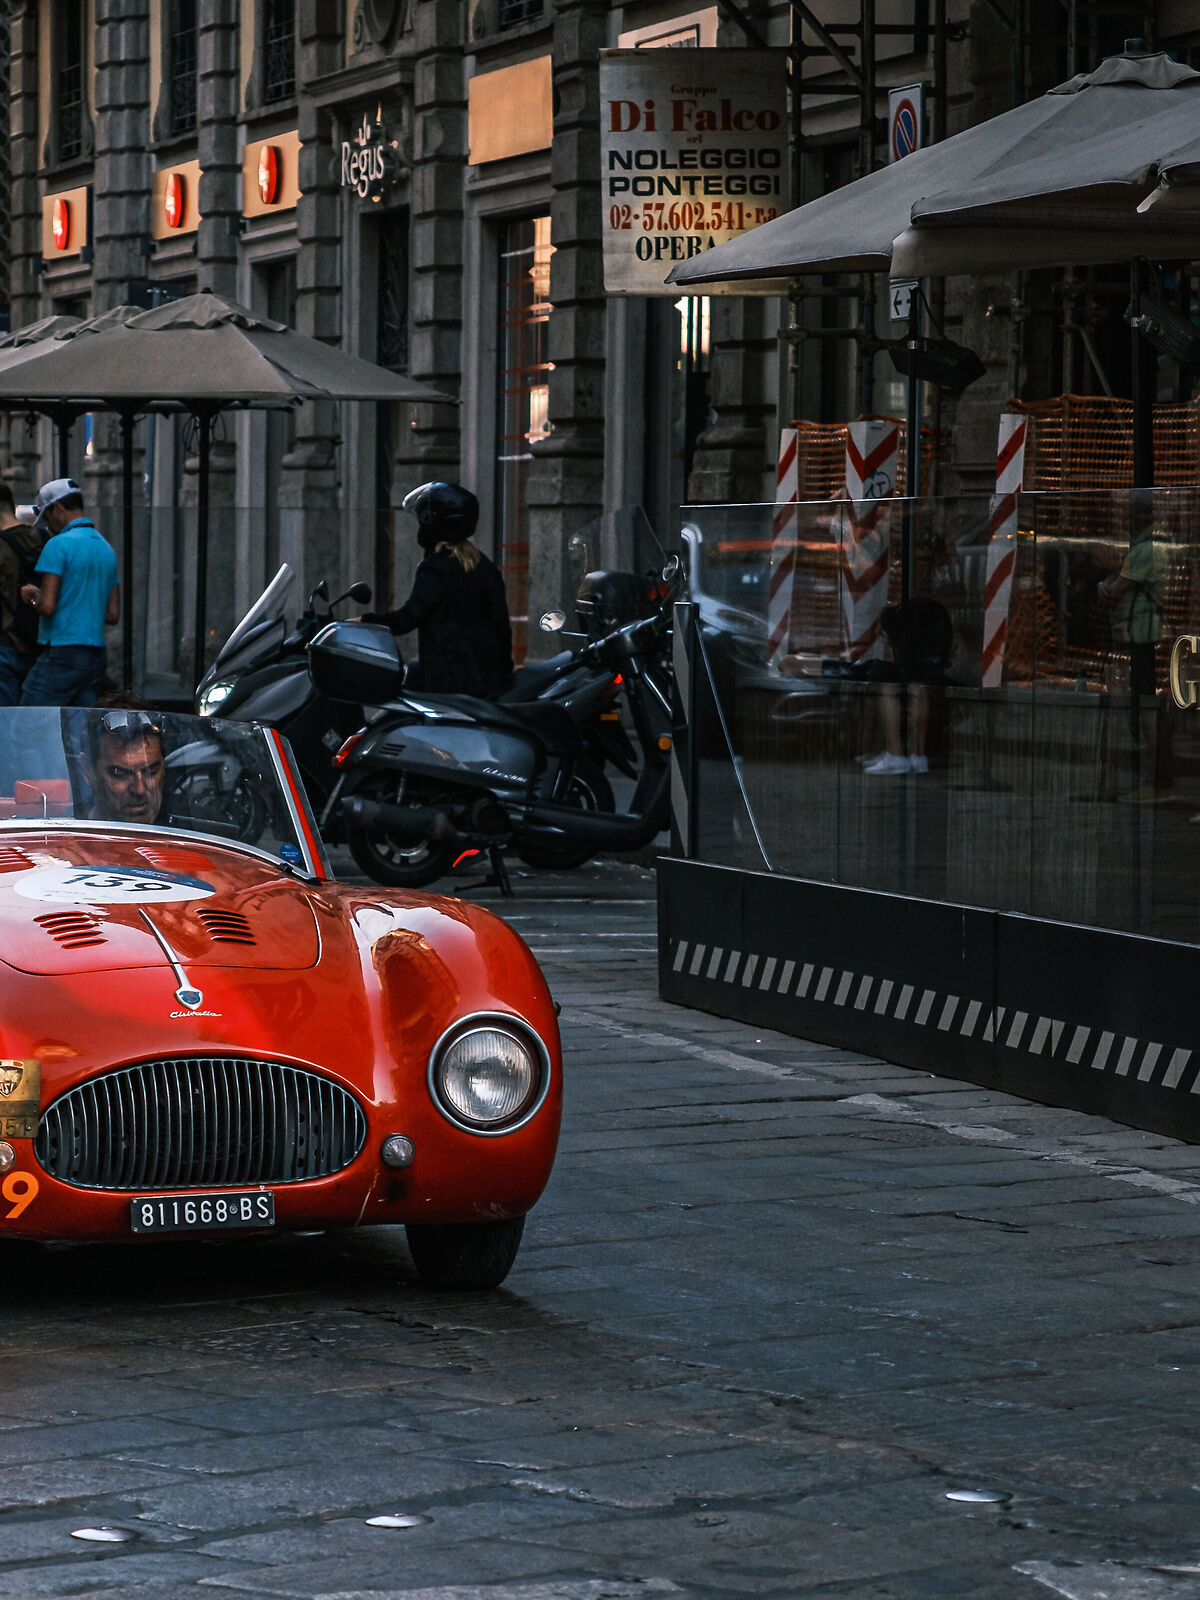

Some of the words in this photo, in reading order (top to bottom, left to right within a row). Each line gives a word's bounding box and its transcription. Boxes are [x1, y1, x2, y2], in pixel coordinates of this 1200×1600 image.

[670, 84, 717, 97] Gruppo
[608, 99, 658, 132] Di
[670, 98, 781, 132] Falco
[686, 134, 703, 144] srl
[341, 142, 385, 198] Regus
[608, 148, 782, 171] NOLEGGIO
[609, 174, 780, 197] PONTEGGI
[62, 873, 173, 892] 139
[141, 1198, 229, 1228] 811668
[239, 1195, 270, 1221] BS
